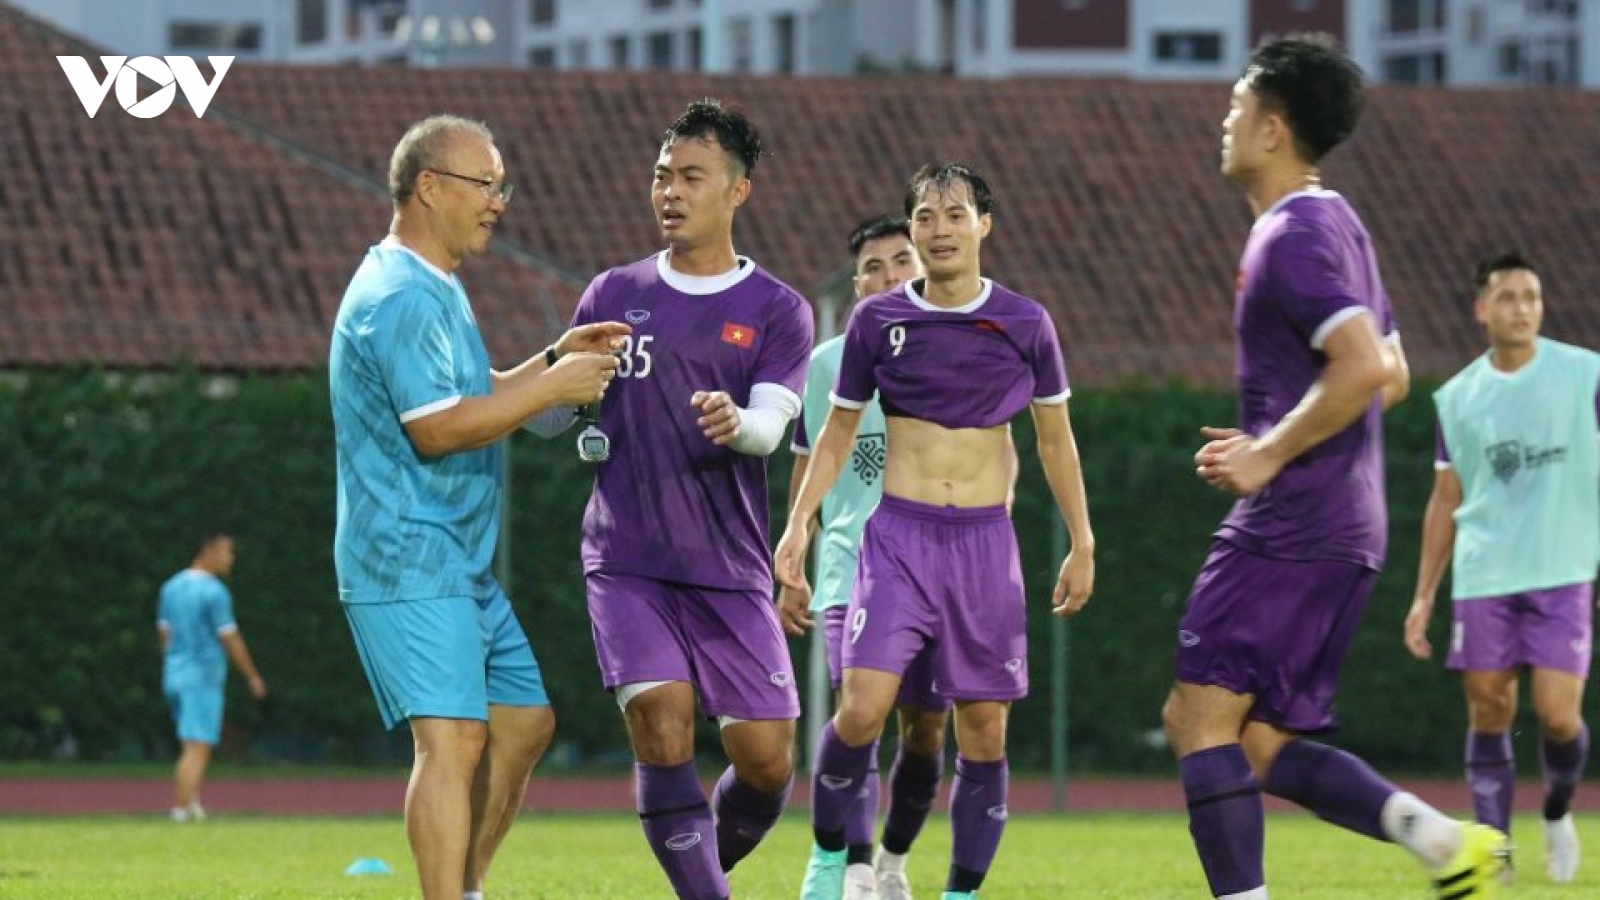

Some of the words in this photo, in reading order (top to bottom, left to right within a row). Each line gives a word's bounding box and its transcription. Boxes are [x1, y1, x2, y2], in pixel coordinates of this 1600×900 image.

[616, 334, 654, 379] 35
[889, 326, 906, 356] 9
[851, 608, 867, 644] 9
